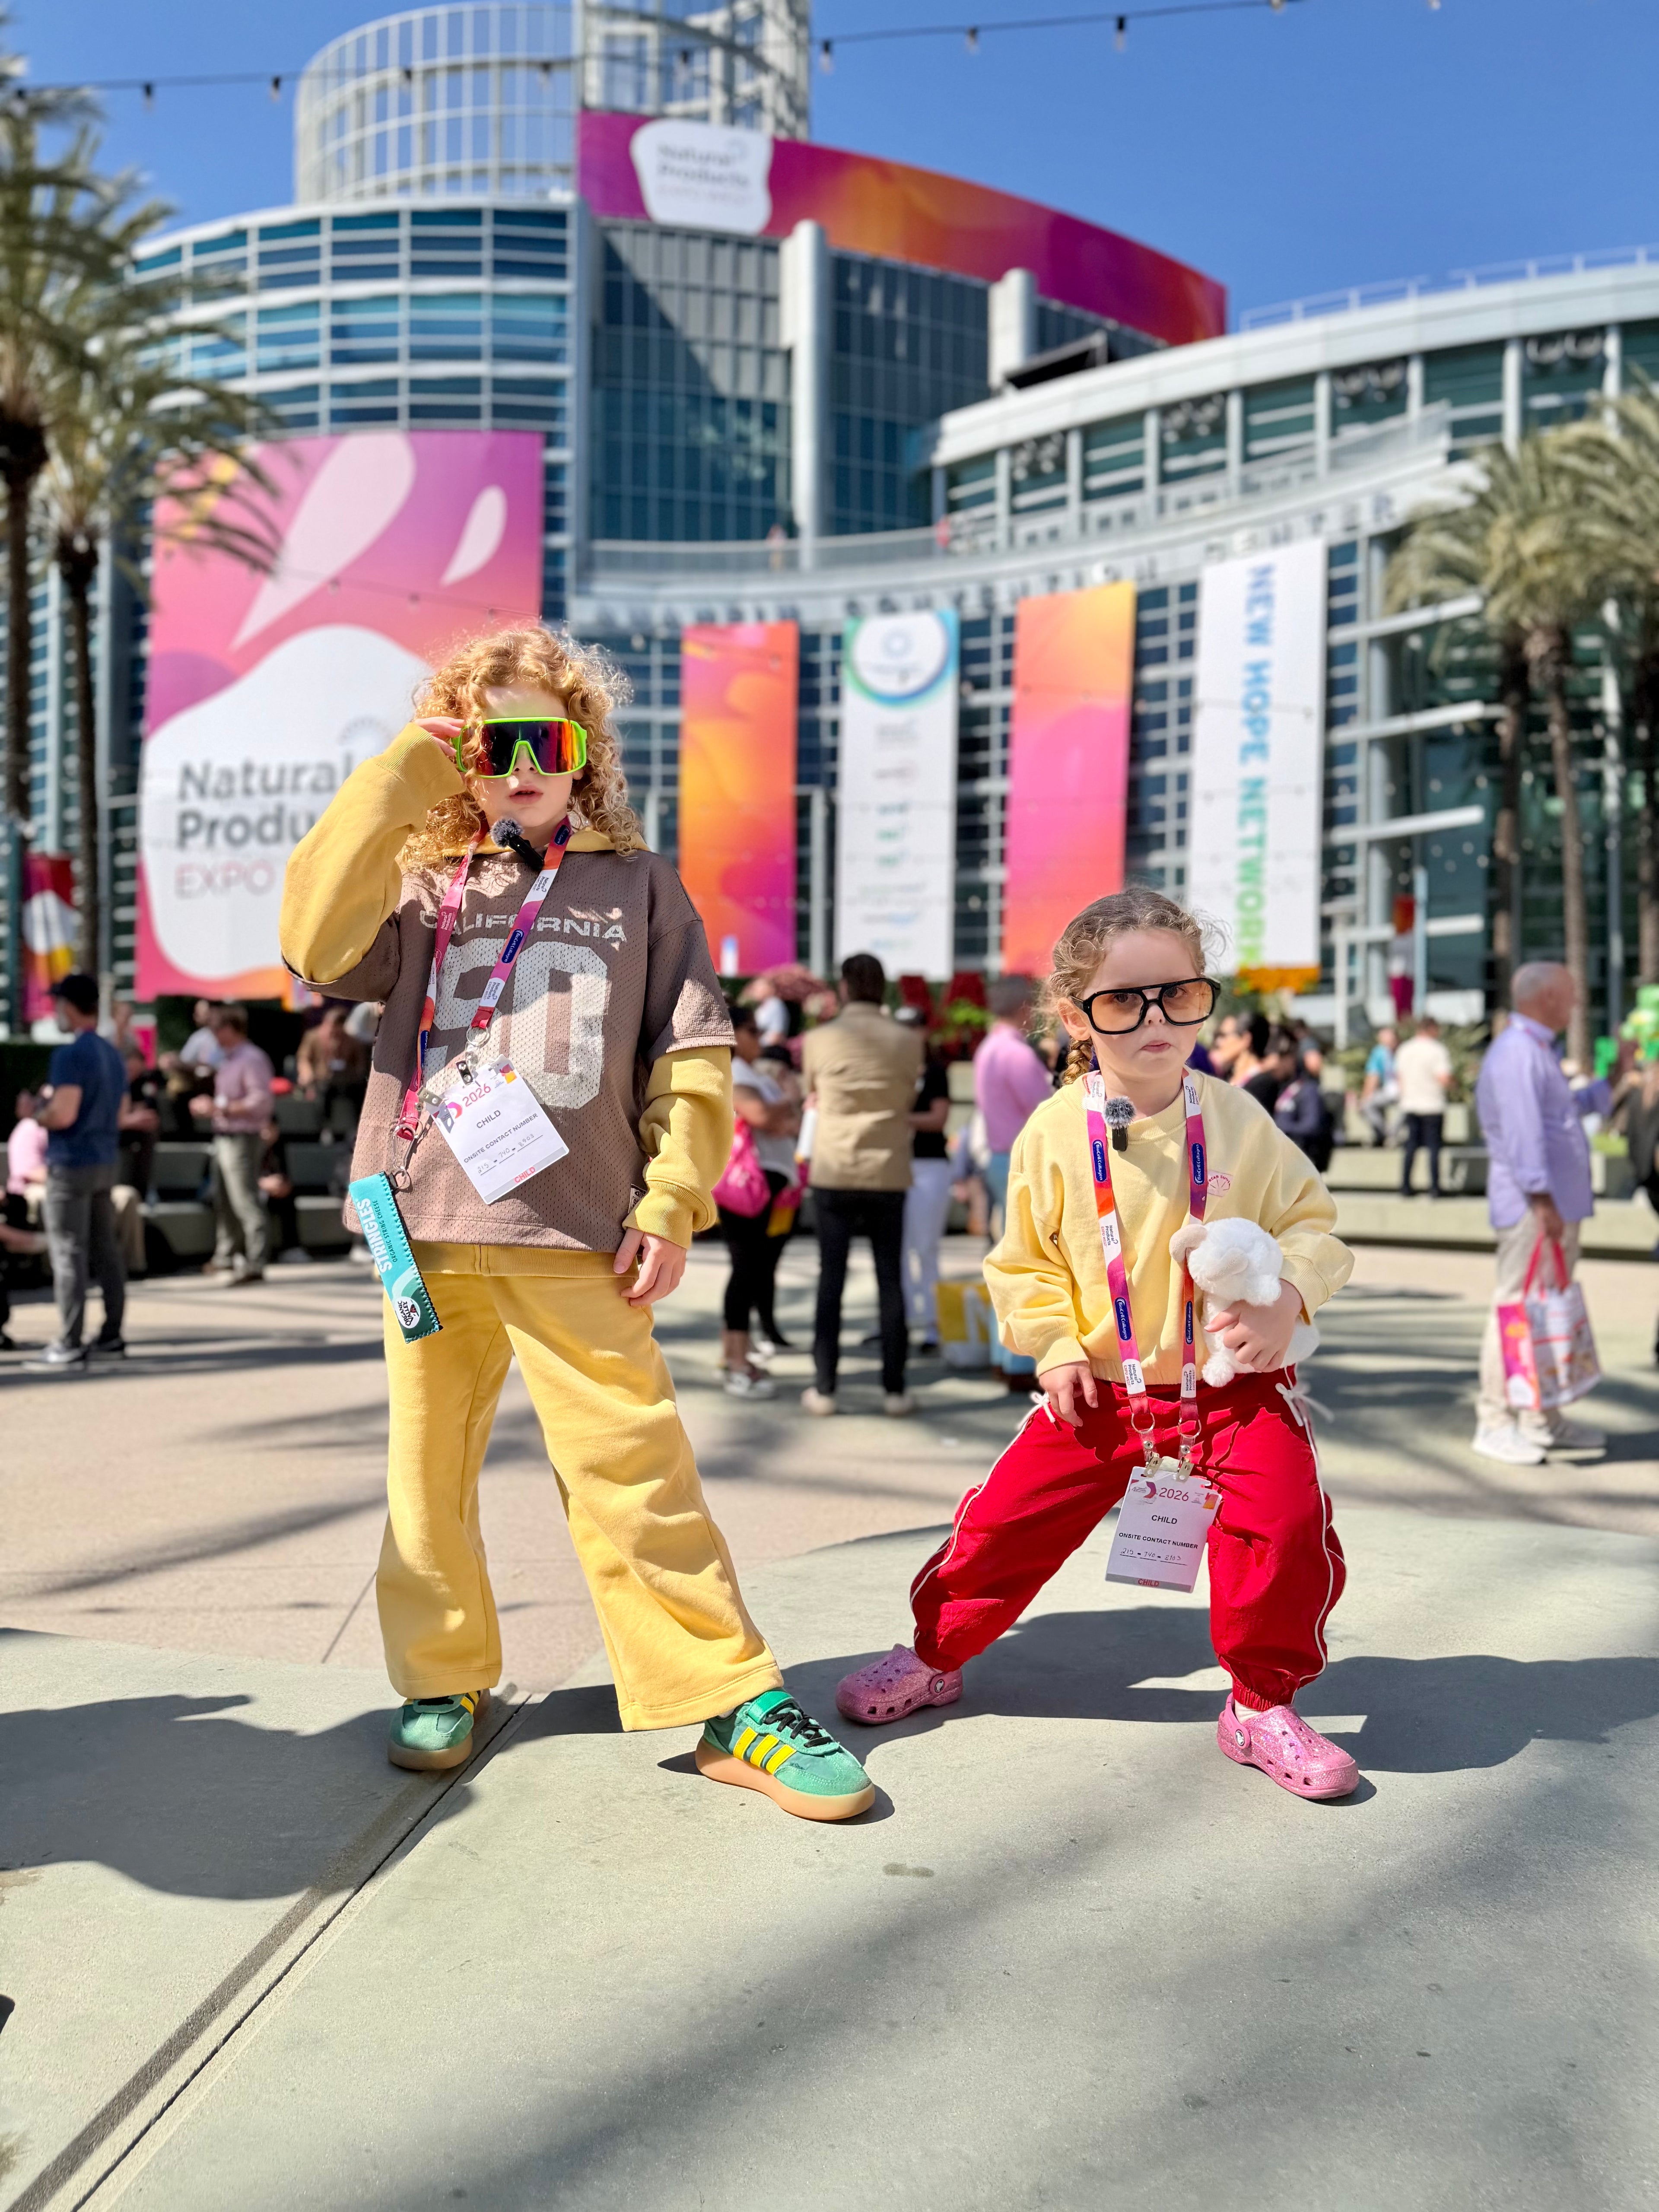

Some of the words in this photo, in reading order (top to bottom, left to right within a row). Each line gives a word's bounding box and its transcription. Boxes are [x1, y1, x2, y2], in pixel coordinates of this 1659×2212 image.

[1245, 563, 1276, 646] NEW
[1238, 661, 1272, 765] HOPE
[177, 754, 354, 801] Natural
[176, 859, 276, 899] EXPO
[1235, 775, 1269, 966] NETWORK
[420, 909, 627, 943] CLIFRNIA
[462, 1083, 491, 1107] 2026
[476, 1109, 501, 1128] CHILD
[464, 1147, 485, 1163] ONSITE
[485, 1129, 512, 1149] CONTACT
[512, 1113, 538, 1132] NUMBER
[514, 1166, 536, 1184] CHILD
[372, 1200, 383, 1219] CHEESE
[379, 1220, 390, 1238] STRING
[386, 1239, 398, 1262] ORGANIC
[397, 1300, 411, 1326] ORGANIC
[403, 1301, 414, 1323] VALLEY
[1159, 1487, 1189, 1501] 2026
[1151, 1515, 1177, 1524] CHILD
[1142, 1536, 1171, 1545] CONTACT
[1138, 1578, 1159, 1587] CHILD
